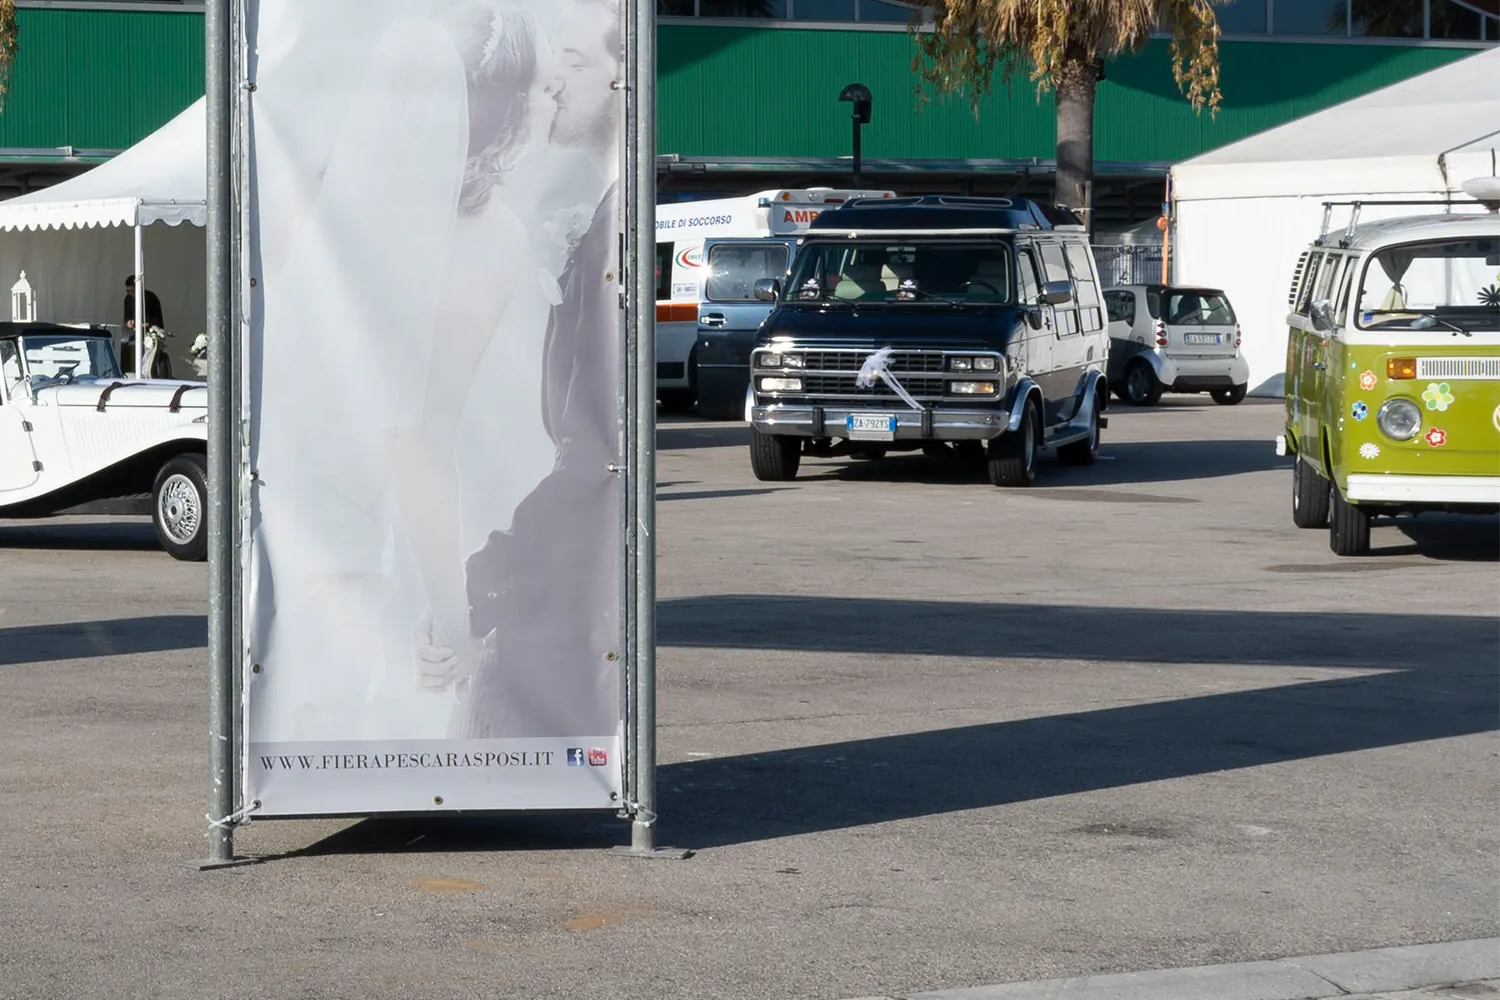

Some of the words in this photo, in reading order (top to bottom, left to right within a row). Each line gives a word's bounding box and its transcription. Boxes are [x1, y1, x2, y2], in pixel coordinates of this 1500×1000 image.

[655, 219, 676, 229] OBILE
[688, 215, 732, 227] SOCCORSO
[260, 751, 555, 771] WWW.FIERAPESCARASPOSI.IT
